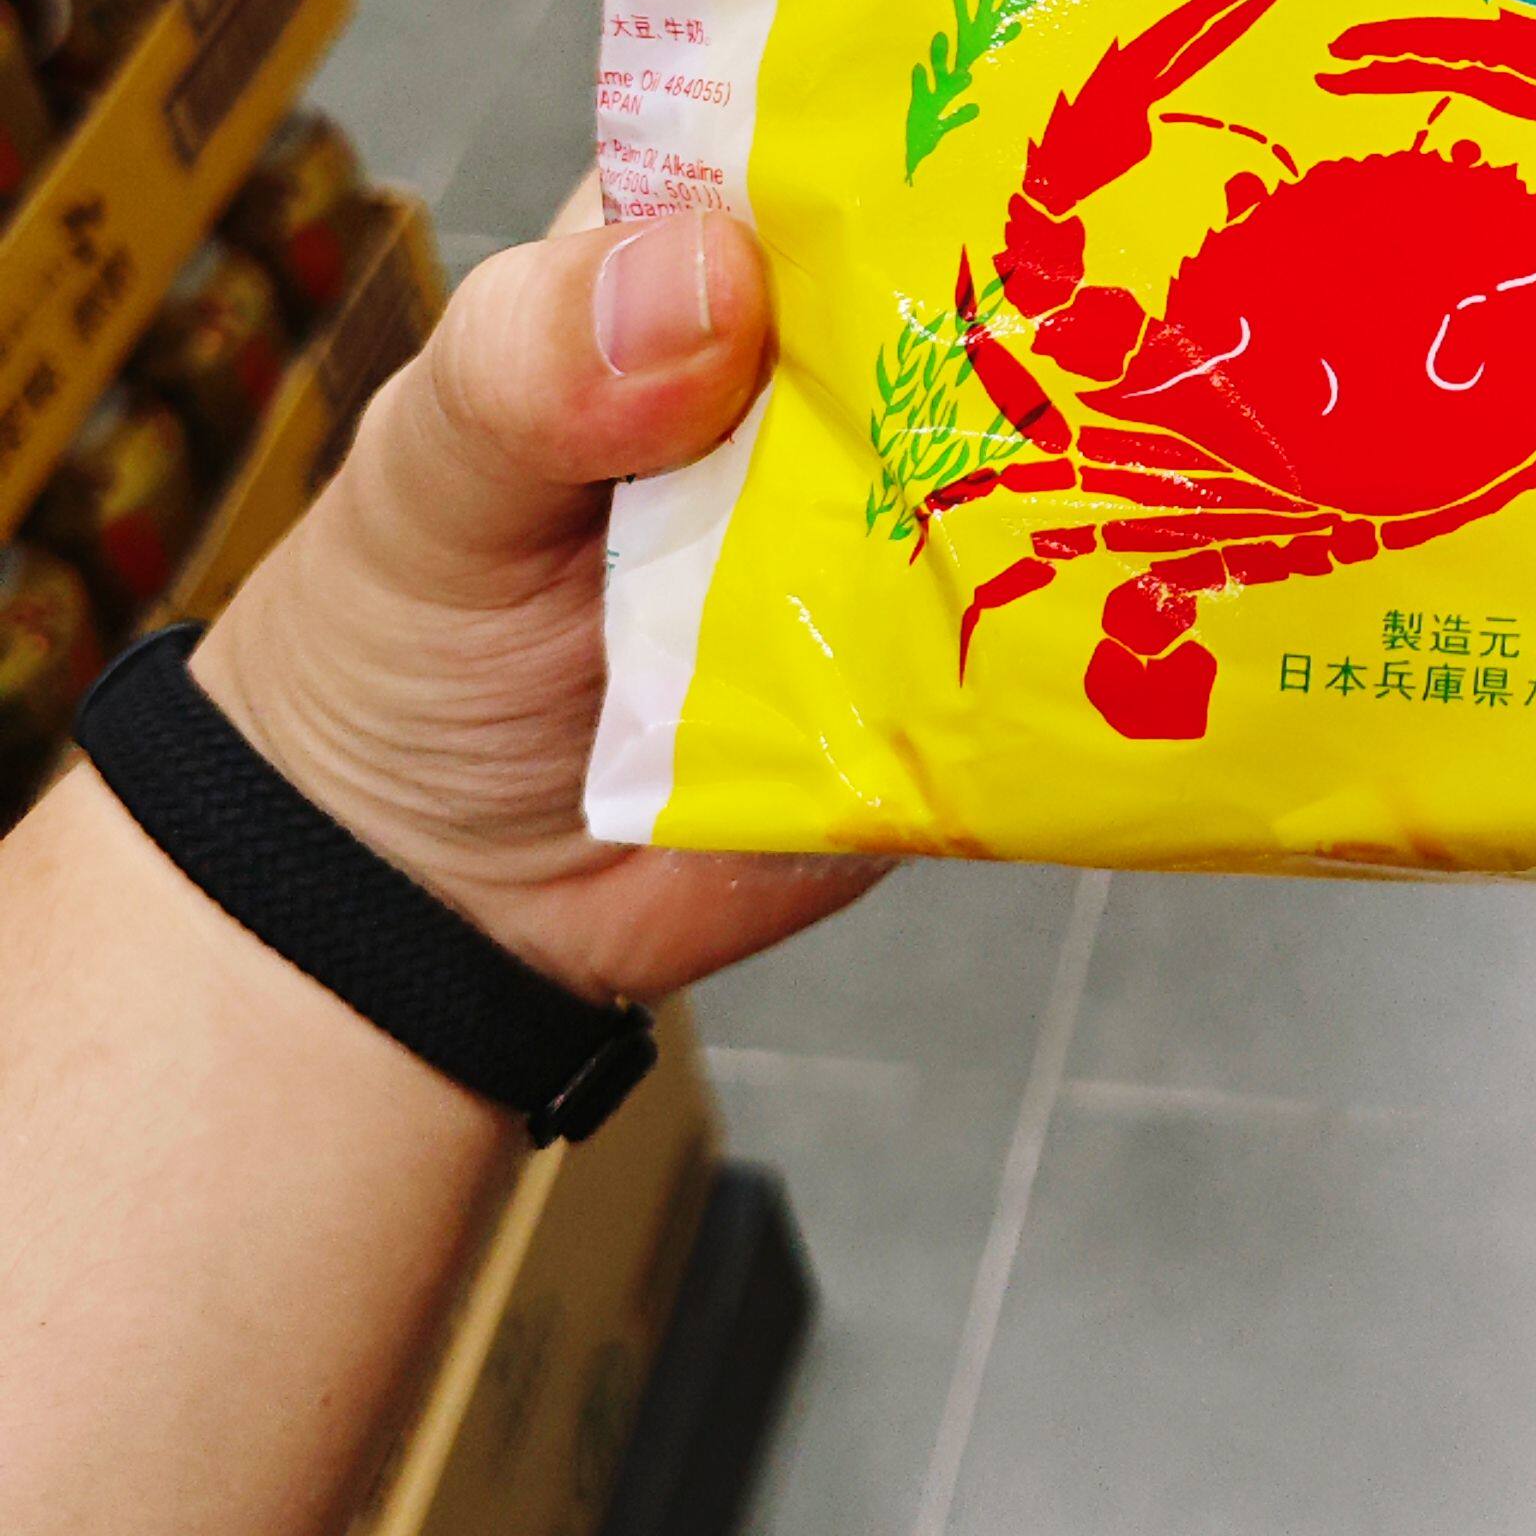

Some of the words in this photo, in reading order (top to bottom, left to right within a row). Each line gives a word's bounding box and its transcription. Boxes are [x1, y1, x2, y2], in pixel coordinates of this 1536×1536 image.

[661, 152, 724, 186] Alkaline
[1382, 609, 1521, 659] 製造元
